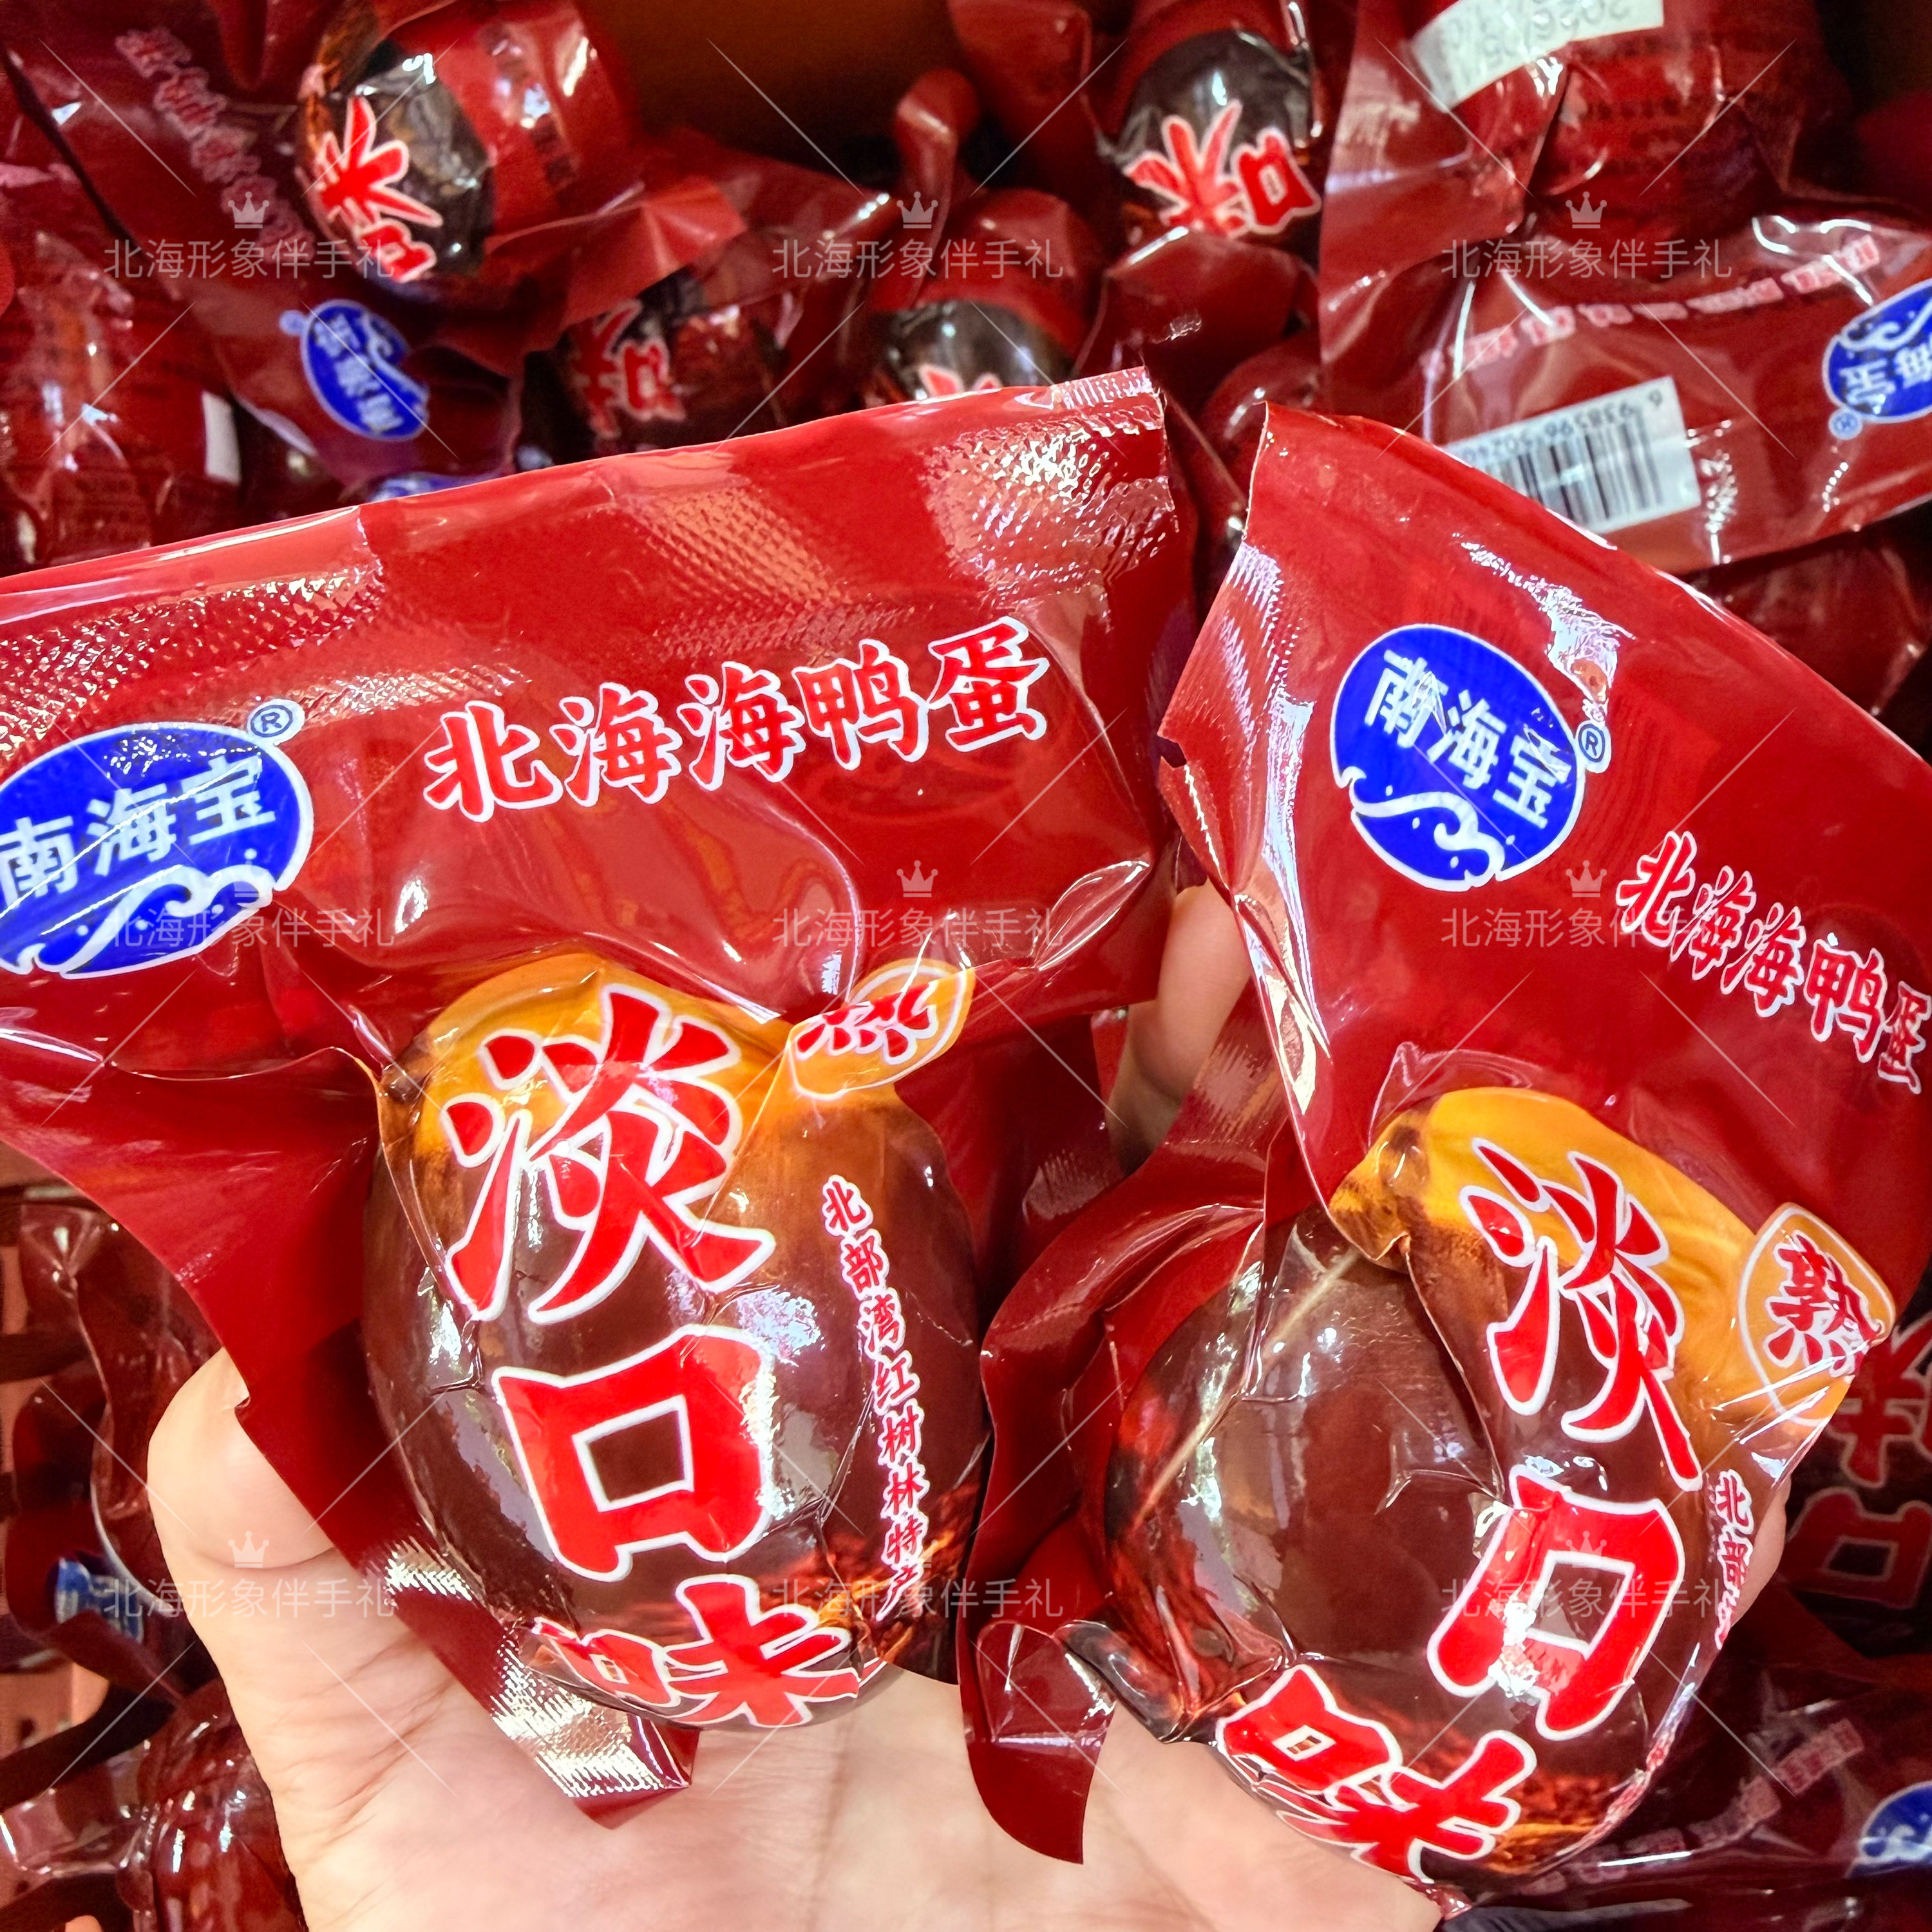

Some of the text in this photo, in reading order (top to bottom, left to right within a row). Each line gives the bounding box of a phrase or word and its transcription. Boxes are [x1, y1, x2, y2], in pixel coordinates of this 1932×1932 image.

[0, 755, 276, 900] 南海宝
[422, 616, 1049, 822] 北海海鸭蛋
[1363, 650, 1572, 829] 南海宝
[1616, 830, 1932, 1094] 北海海鸭蛋
[445, 984, 859, 1728] 淡口味
[820, 1174, 926, 1621] 北部湾红树林特产
